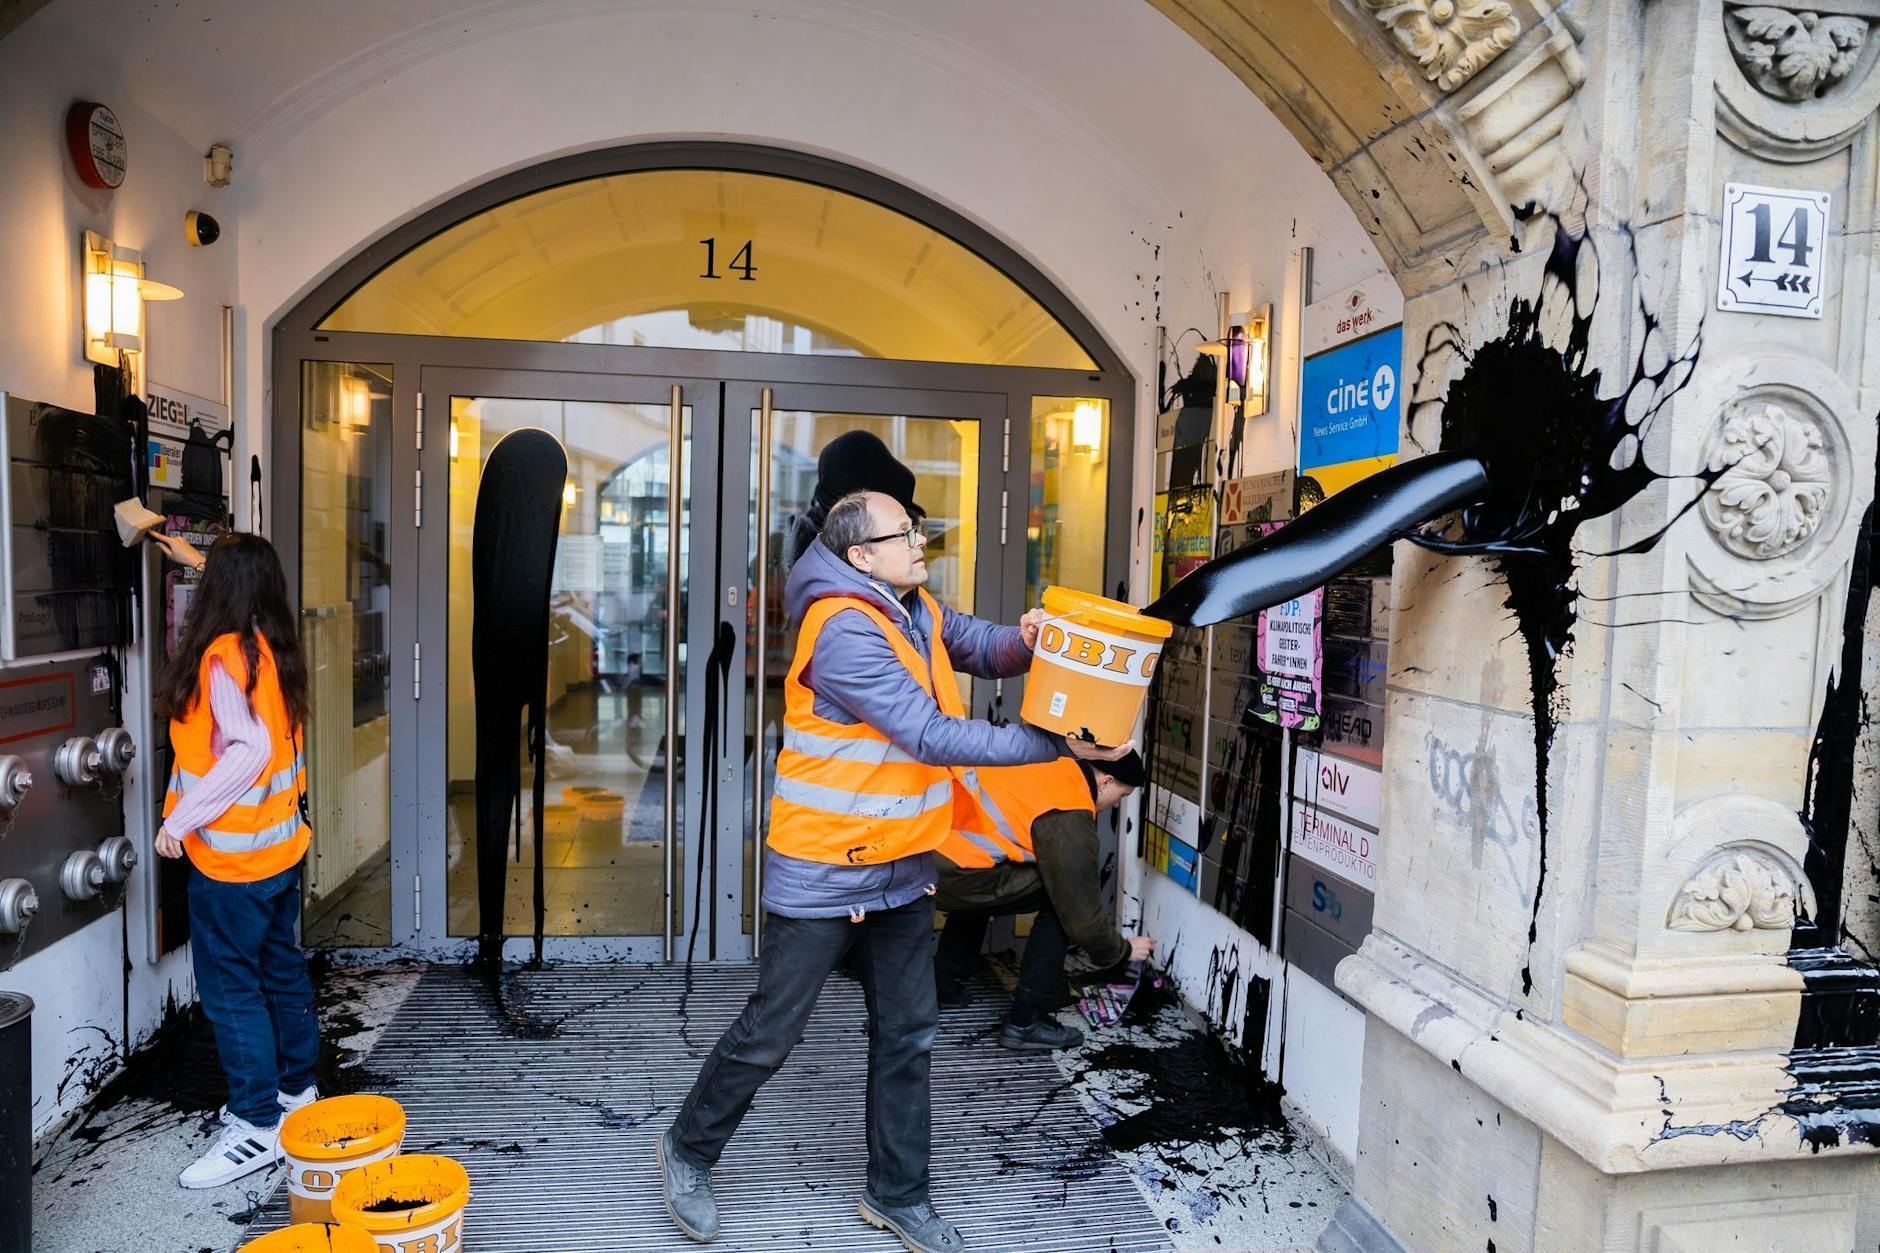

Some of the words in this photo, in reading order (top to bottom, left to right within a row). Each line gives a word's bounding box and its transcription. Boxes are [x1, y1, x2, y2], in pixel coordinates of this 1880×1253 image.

[1745, 203, 1813, 268] 14
[699, 237, 758, 281] 14
[1337, 319, 1351, 334] das
[1352, 308, 1373, 329] werk
[147, 394, 188, 426] ZIEGEL
[1350, 413, 1368, 429] GmbH
[1270, 620, 1312, 635] KLIMAPOLITISCHE
[1041, 623, 1137, 675] OBI
[1321, 763, 1350, 796] alv
[1299, 811, 1357, 854] TERMINAL
[1360, 837, 1369, 858] D
[1294, 830, 1377, 881] EDIENPRODUKTIO
